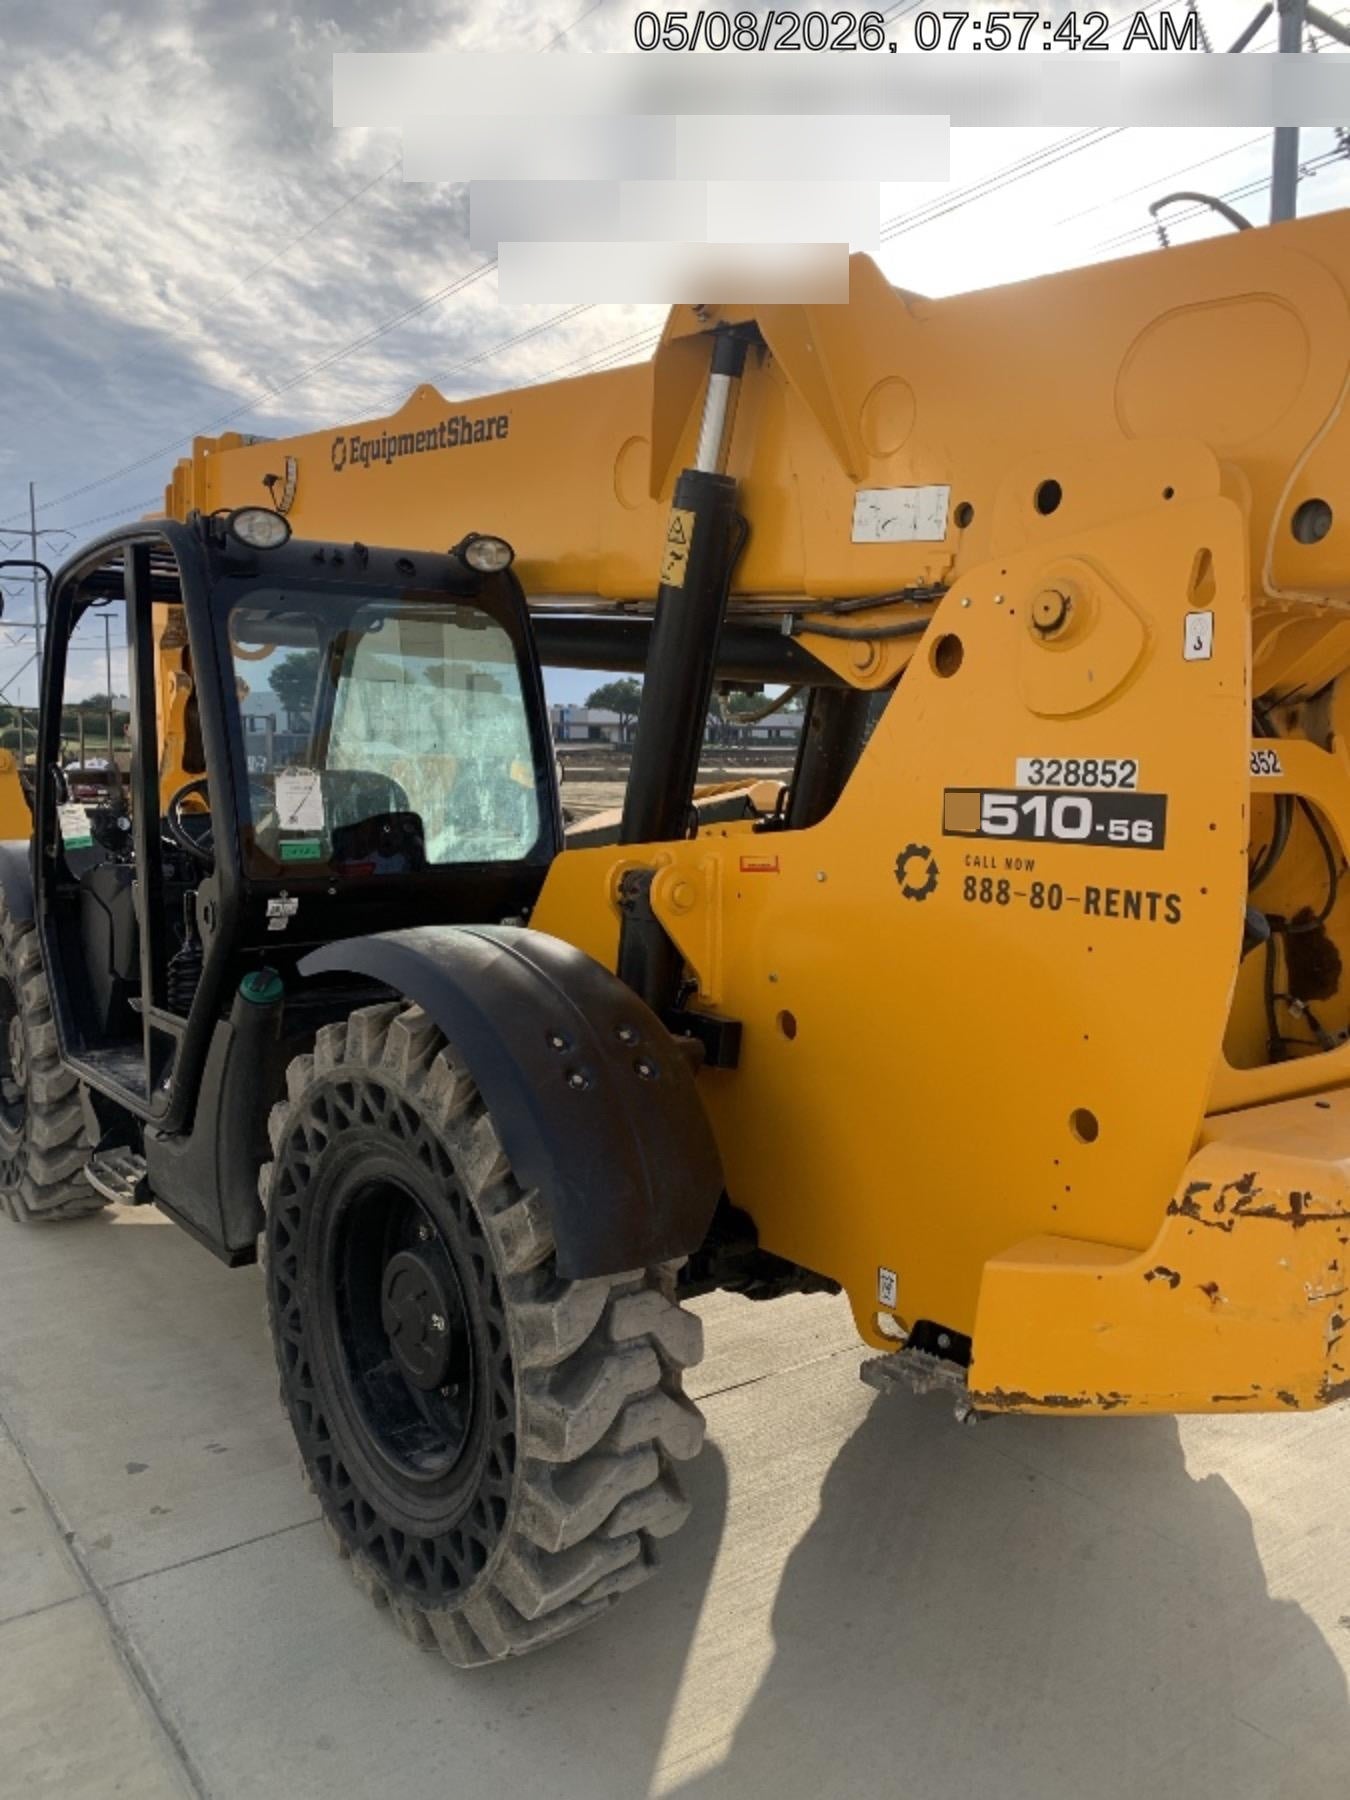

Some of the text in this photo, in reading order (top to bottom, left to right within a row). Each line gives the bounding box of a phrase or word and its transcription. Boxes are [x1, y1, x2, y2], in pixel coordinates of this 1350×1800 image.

[350, 415, 509, 468] EquipmentShare
[1028, 758, 1138, 789] 328852
[980, 793, 1154, 843] 510-56
[964, 853, 1036, 872] CALL NOW
[963, 875, 1182, 925] 888-80-RENTS
